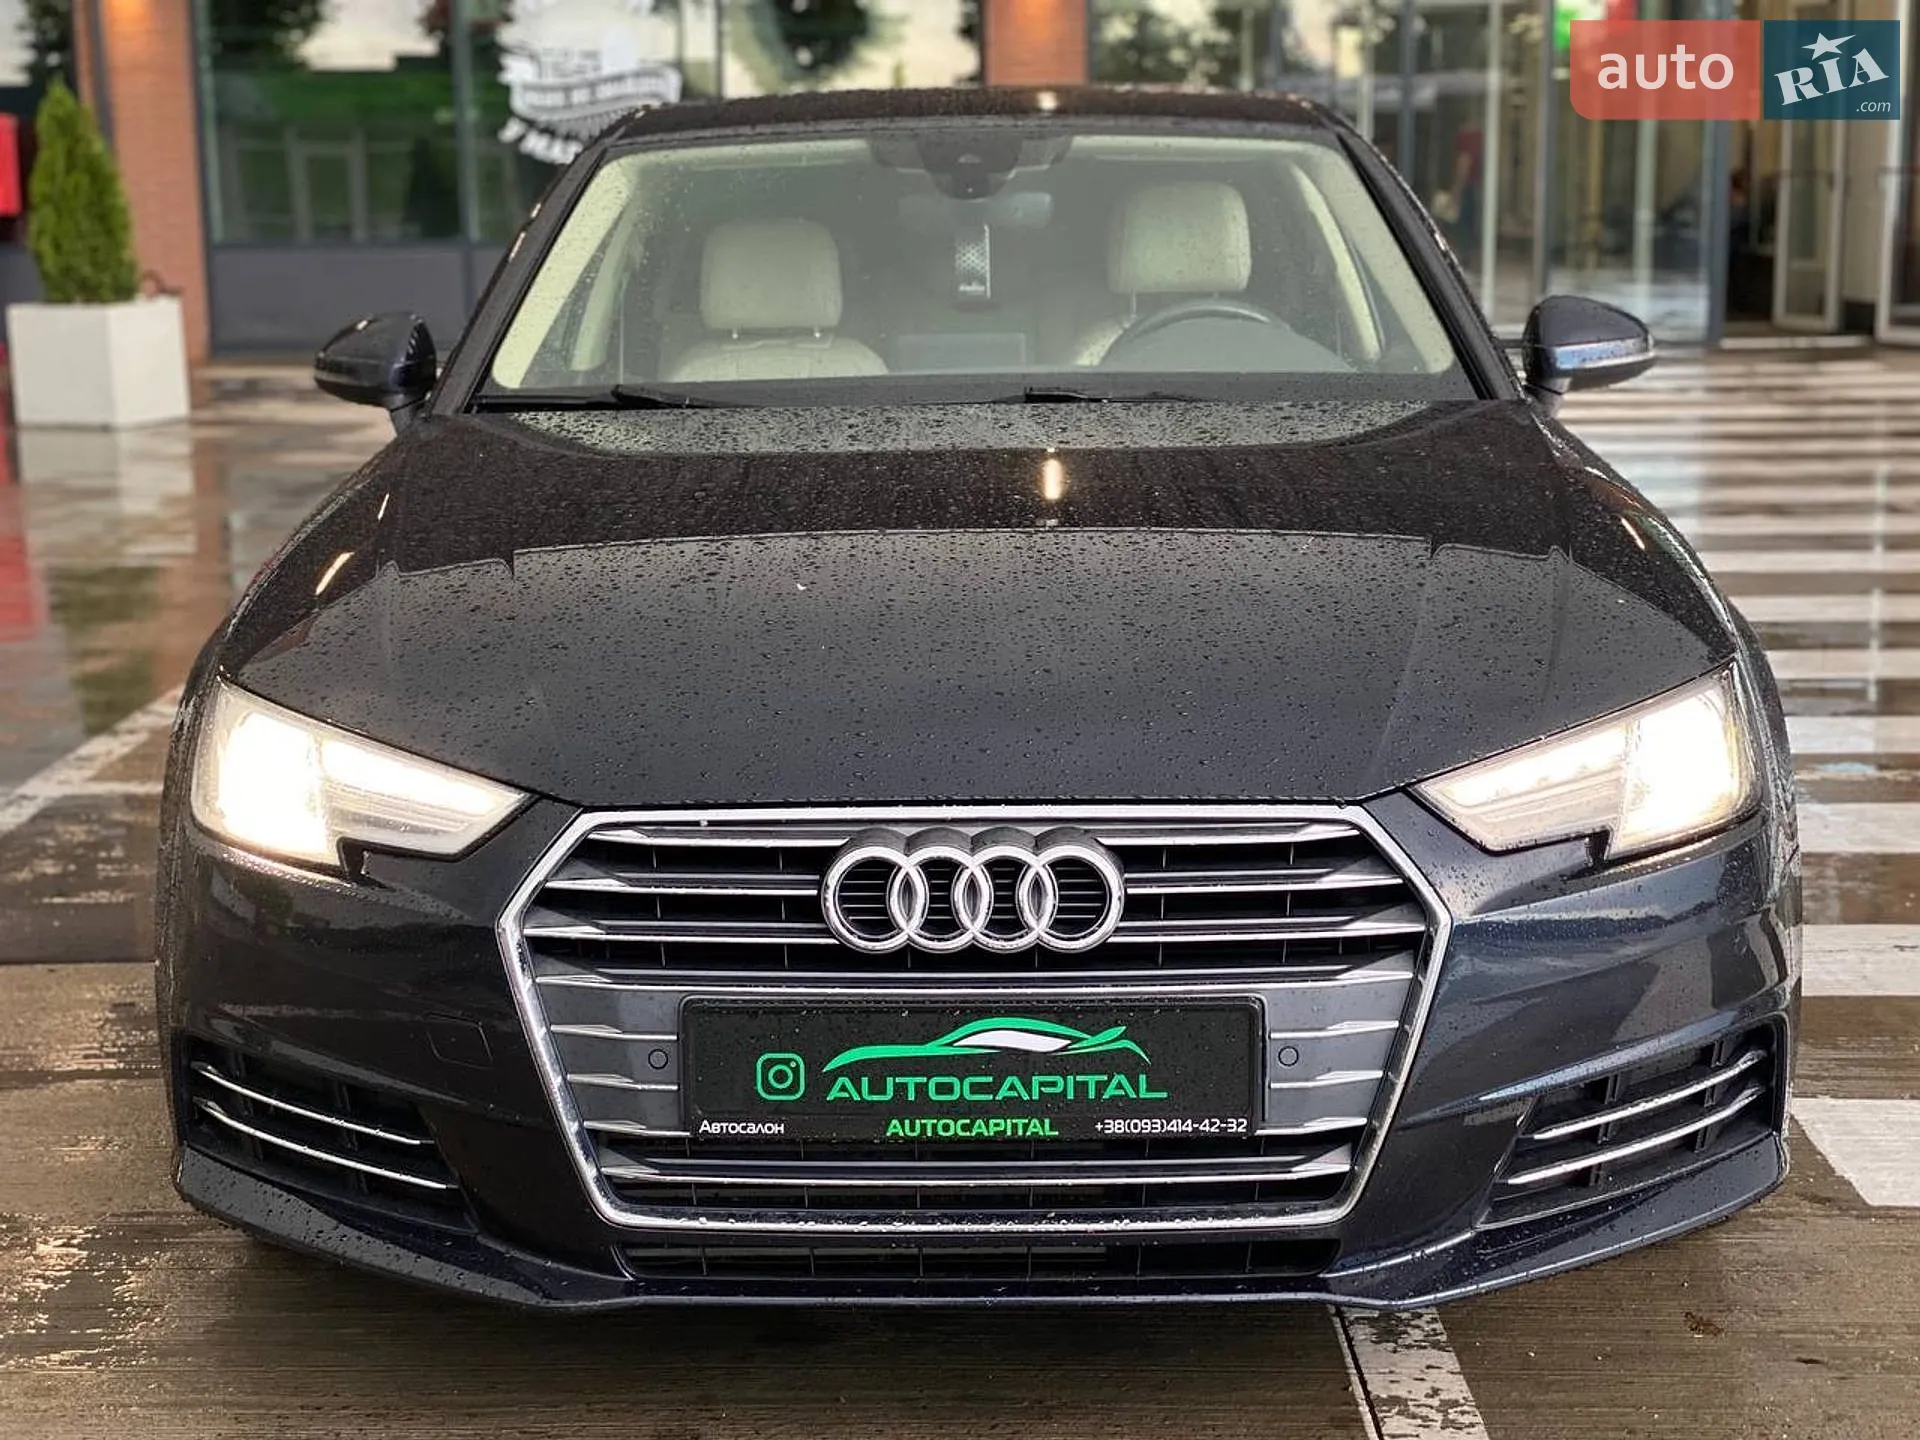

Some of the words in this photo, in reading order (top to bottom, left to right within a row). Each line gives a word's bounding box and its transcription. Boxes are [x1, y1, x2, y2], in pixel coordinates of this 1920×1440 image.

[826, 1074, 1169, 1102] AUTOCAPITAL
[698, 1119, 785, 1135] Автосалон
[886, 1118, 1060, 1137] AUTOCAPITAL
[1094, 1118, 1248, 1134] +38(093)414-42-32
